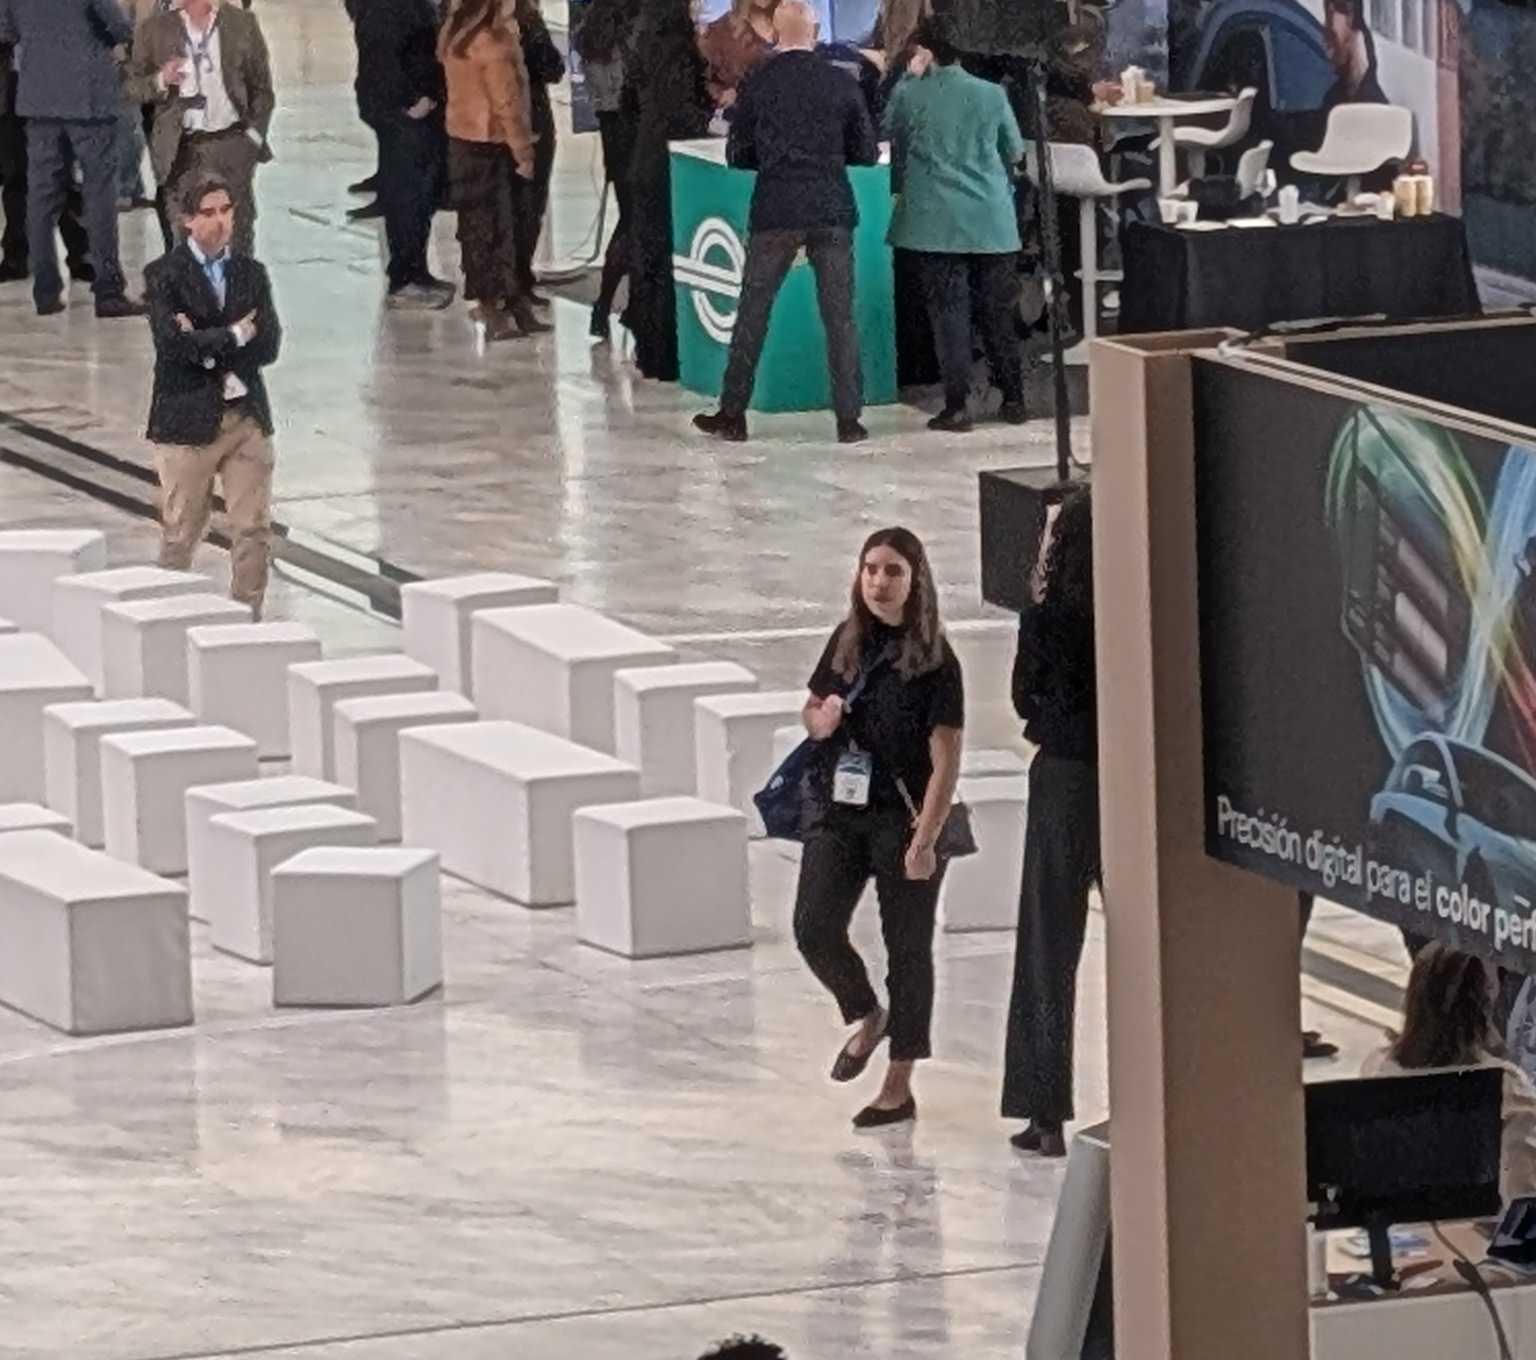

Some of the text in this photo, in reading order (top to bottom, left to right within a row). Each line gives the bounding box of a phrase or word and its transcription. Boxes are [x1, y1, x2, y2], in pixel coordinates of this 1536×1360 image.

[1217, 795, 1301, 864] Precisión
[1304, 828, 1363, 889] digital
[1366, 860, 1412, 905] para
[1413, 874, 1433, 912] el
[1436, 885, 1489, 935] color
